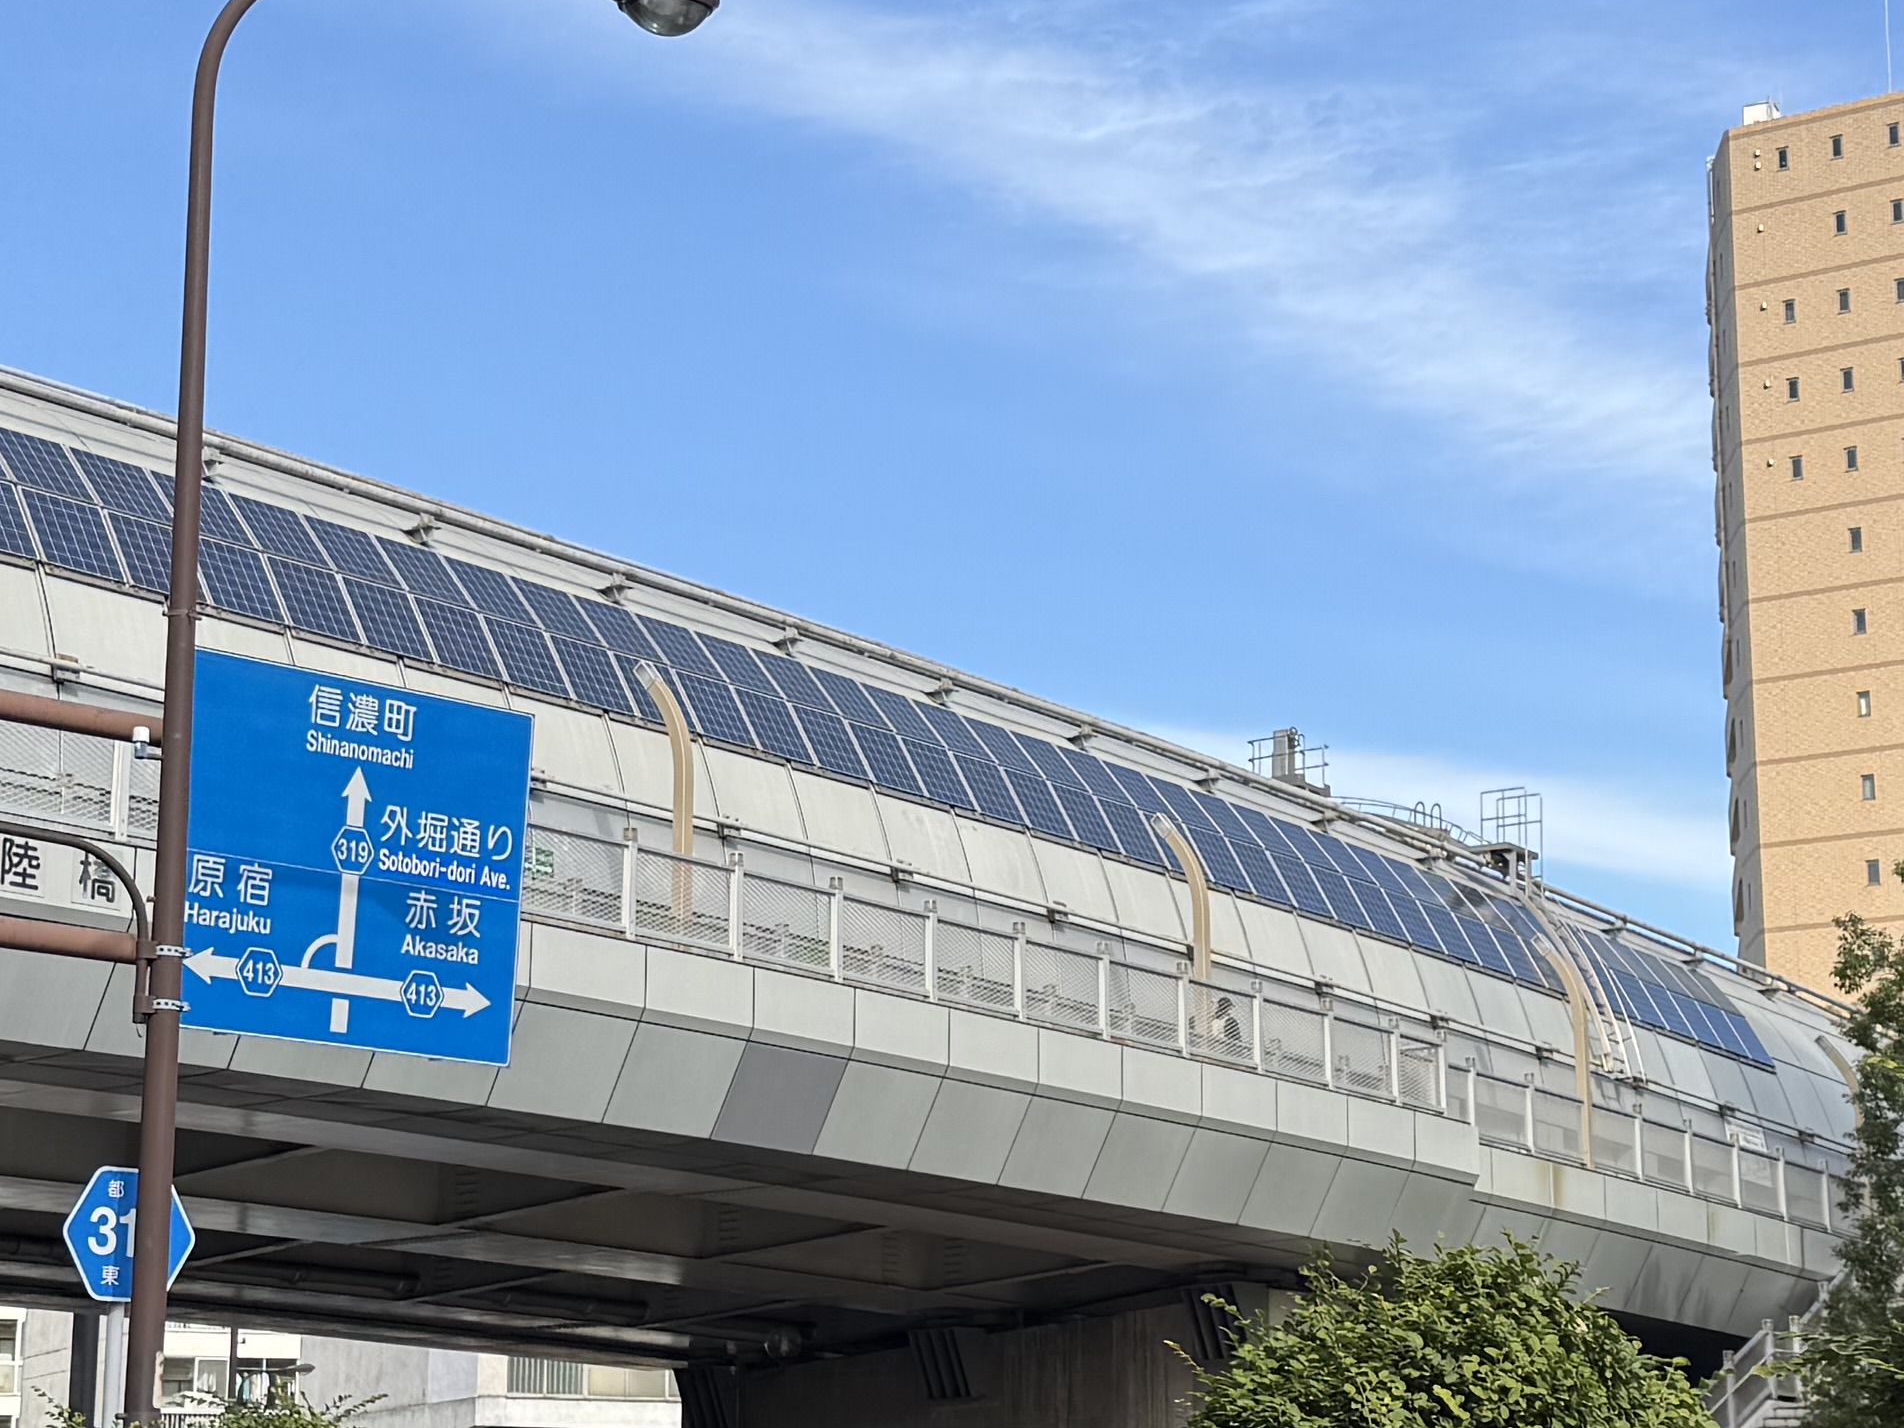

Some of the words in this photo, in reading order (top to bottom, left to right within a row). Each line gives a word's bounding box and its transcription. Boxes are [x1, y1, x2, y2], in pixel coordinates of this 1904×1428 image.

[308, 683, 417, 742] 信濃町
[306, 729, 414, 769] Shinanomachi
[379, 804, 513, 861] 外堀通り
[336, 839, 369, 864] 319
[378, 847, 476, 885] Sotobori-dori
[479, 865, 511, 891] Ave.
[187, 853, 273, 907] 原宿
[183, 900, 272, 935] Harajuku
[404, 889, 481, 939] 赤坂
[400, 933, 479, 965] Akasaka
[242, 959, 275, 985] 413
[406, 982, 437, 1007] 413
[107, 1179, 125, 1199] 都
[87, 1205, 137, 1258] 31
[100, 1264, 120, 1286] 東
